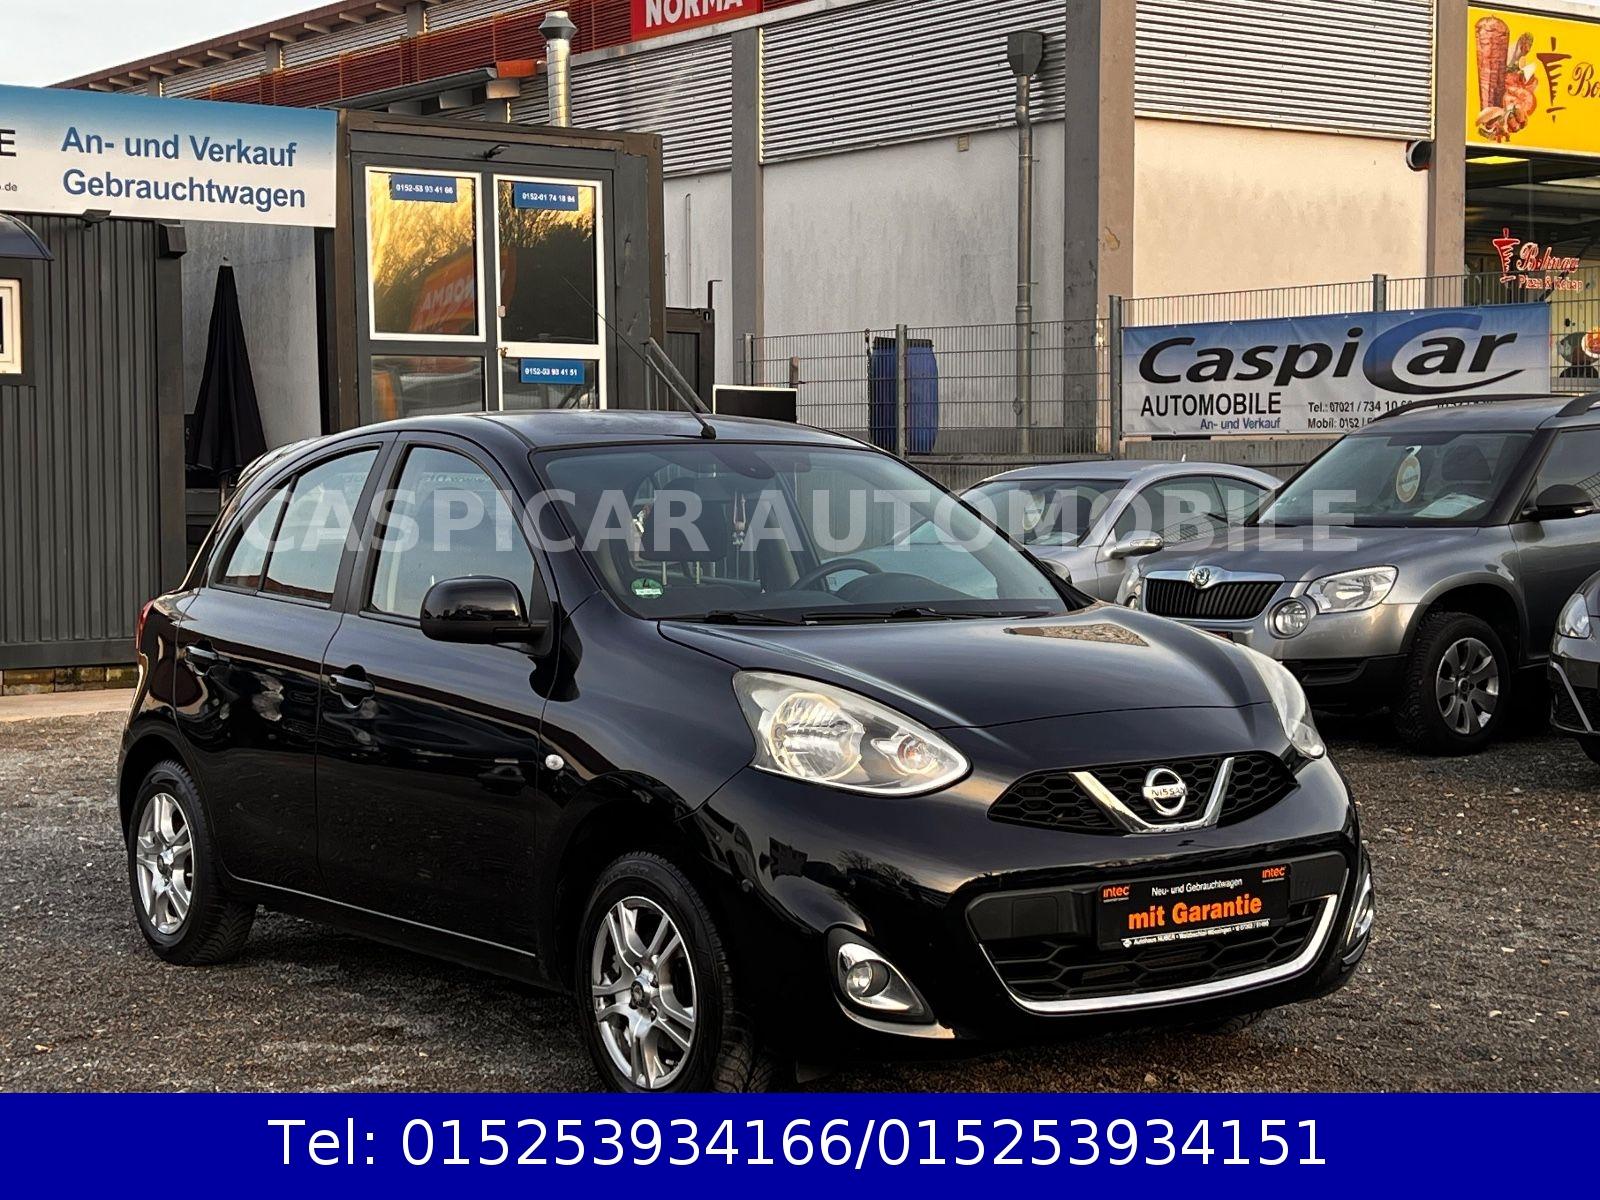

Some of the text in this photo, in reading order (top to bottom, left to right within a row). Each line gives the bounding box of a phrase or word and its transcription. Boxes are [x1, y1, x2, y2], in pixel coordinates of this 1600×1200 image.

[1568, 61, 1600, 98] Bo
[61, 126, 297, 167] An- und Verkauf
[63, 168, 306, 212] Gebrauchtwagen
[1138, 312, 1523, 394] CaspiCar
[1140, 391, 1282, 417] AUTOMOBILE
[1329, 401, 1355, 413] 07021
[1362, 401, 1382, 413] 734
[1200, 416, 1282, 431] An- und Verkauf
[1307, 417, 1338, 429] Mobil:
[1338, 417, 1360, 429] 0152
[1151, 786, 1187, 797] NISSAN
[1151, 877, 1243, 897] Neu- und Gebrauchtwagen
[1127, 893, 1263, 930] mit Garantie
